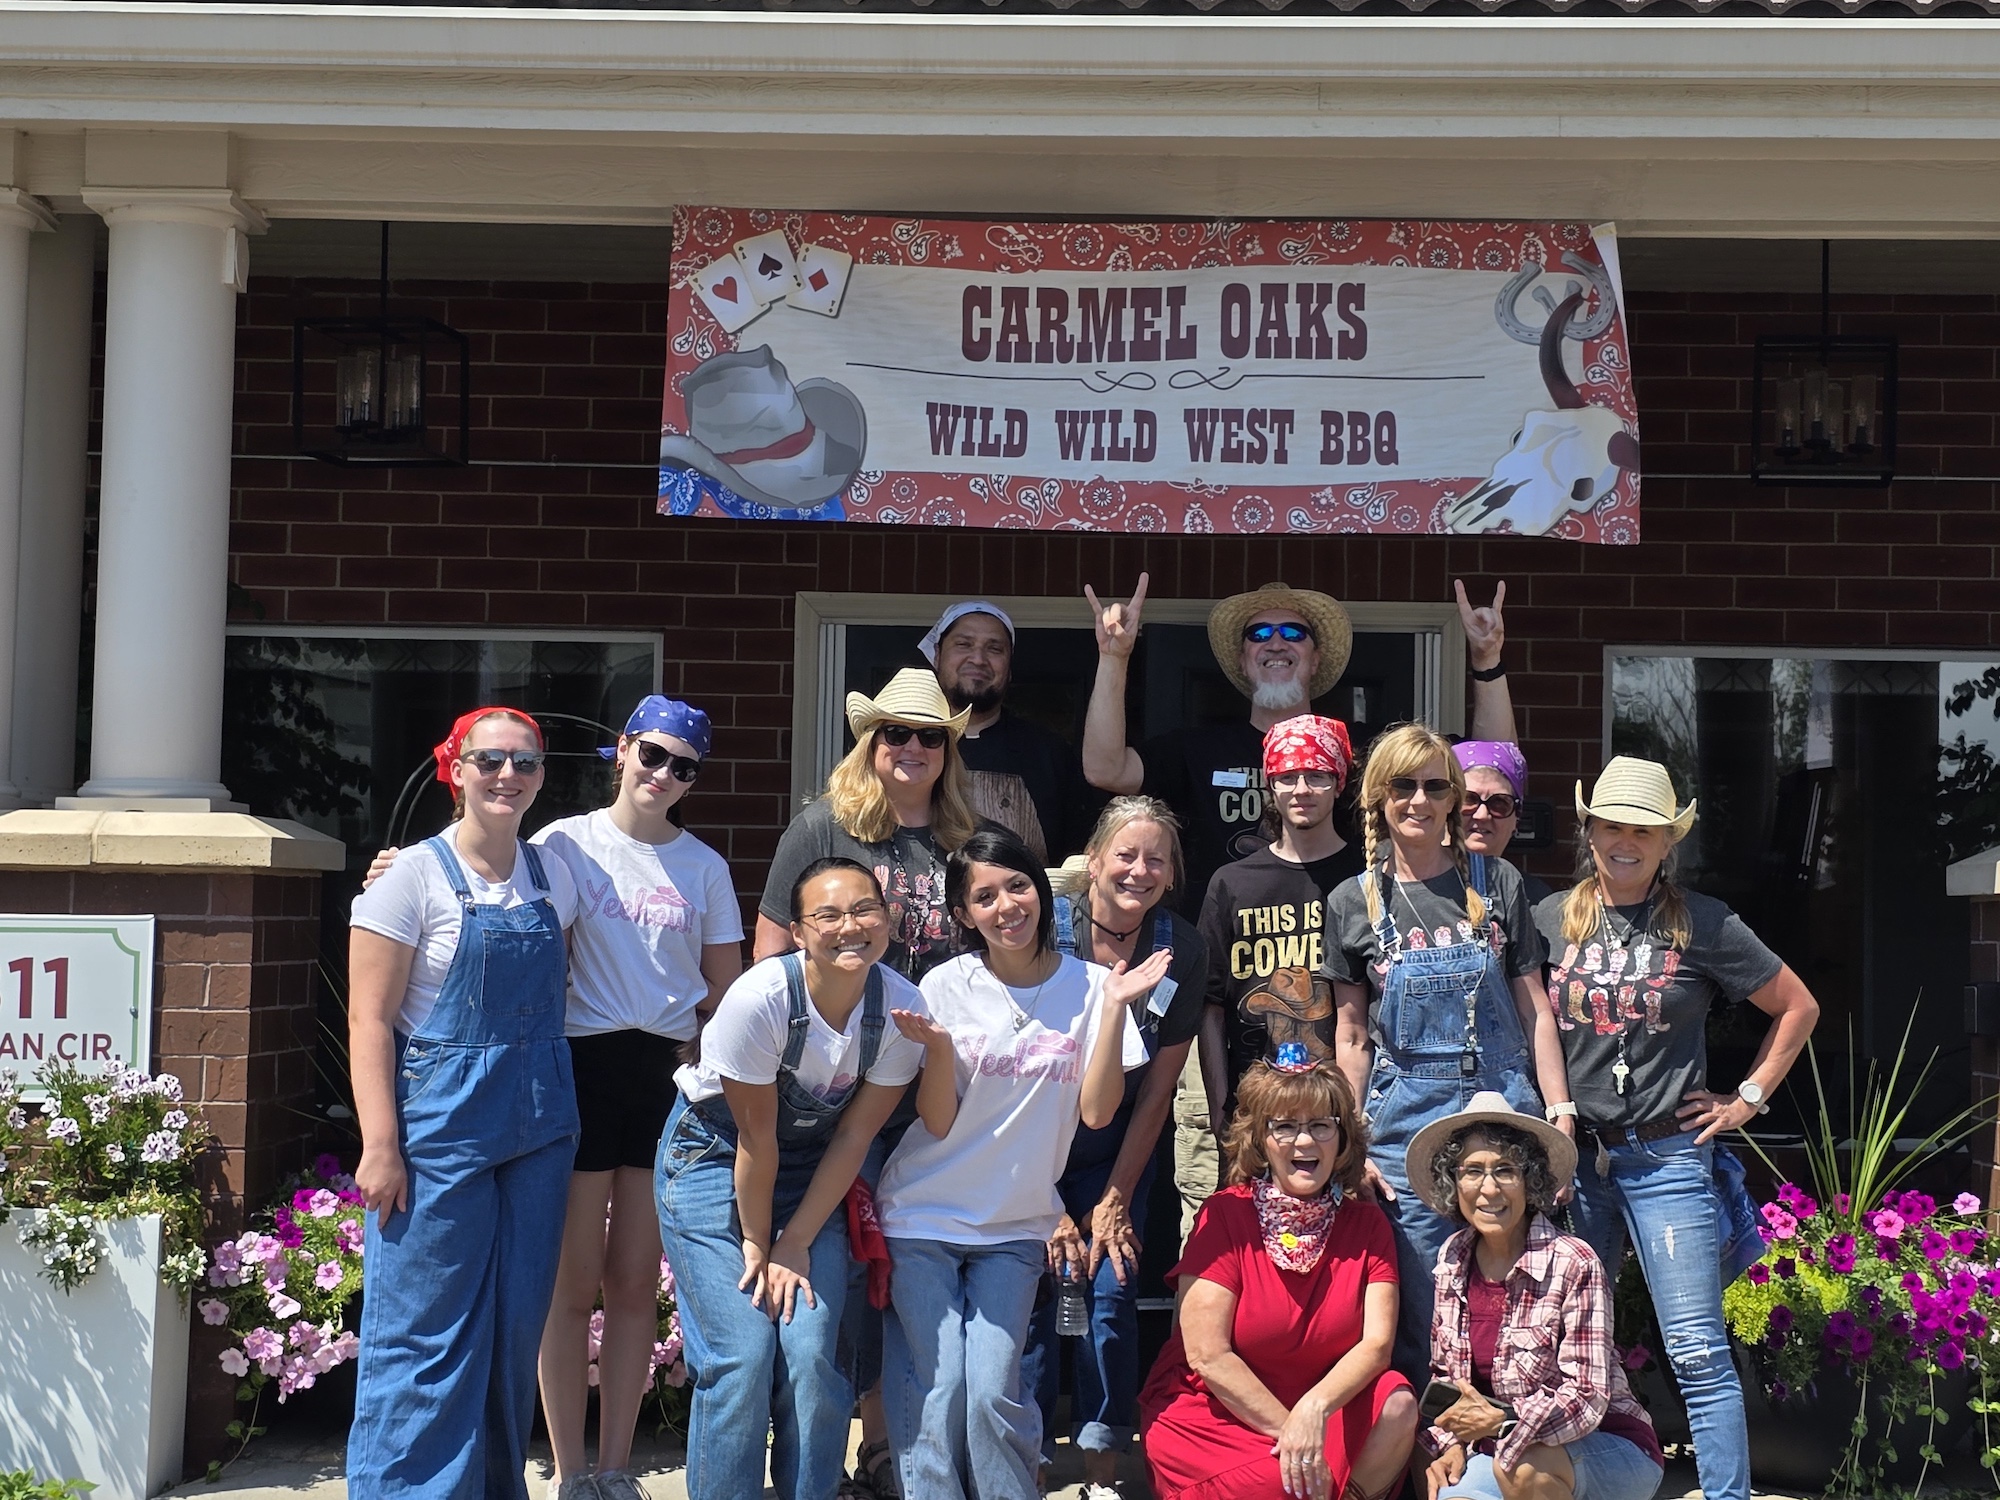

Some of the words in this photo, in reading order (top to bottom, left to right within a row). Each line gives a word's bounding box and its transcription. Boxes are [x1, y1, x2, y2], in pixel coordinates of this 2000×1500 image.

[961, 285, 1198, 365] CARMEL
[1220, 282, 1368, 361] OAKS
[925, 402, 1029, 458] WILD
[1054, 409, 1158, 463] WILD
[1183, 407, 1295, 465] WEST
[1319, 409, 1399, 466] BBQ
[1237, 903, 1297, 936] THIS
[1303, 900, 1323, 930] IS
[0, 957, 69, 1019] 11
[57, 1032, 121, 1061] CIR.
